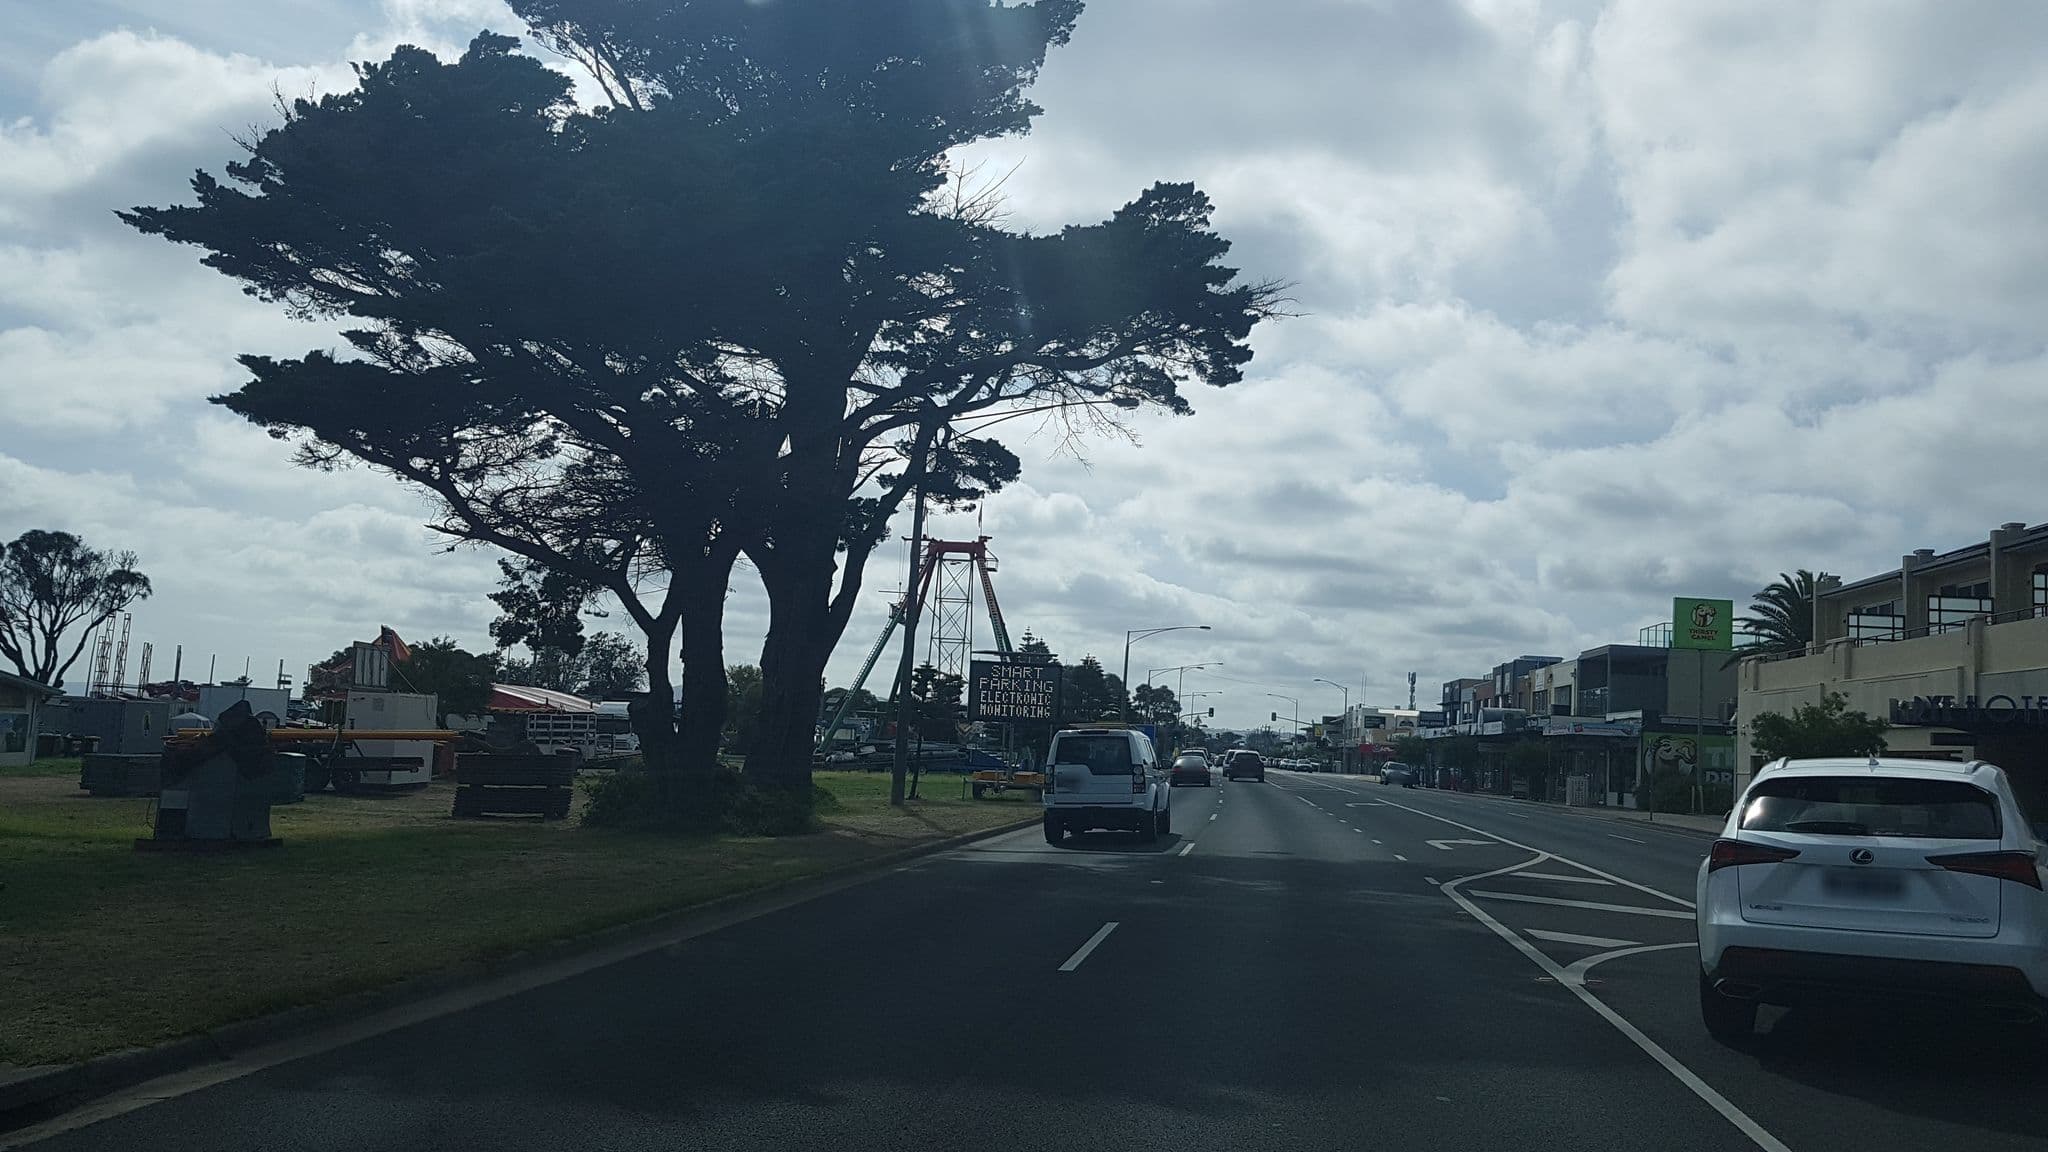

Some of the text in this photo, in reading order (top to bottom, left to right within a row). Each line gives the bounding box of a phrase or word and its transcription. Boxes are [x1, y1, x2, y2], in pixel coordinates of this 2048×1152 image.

[991, 665, 1043, 679] SMART
[979, 677, 1053, 692] PARKING
[980, 690, 1051, 705] ELECTRONIC
[979, 703, 1051, 718] MONITORING
